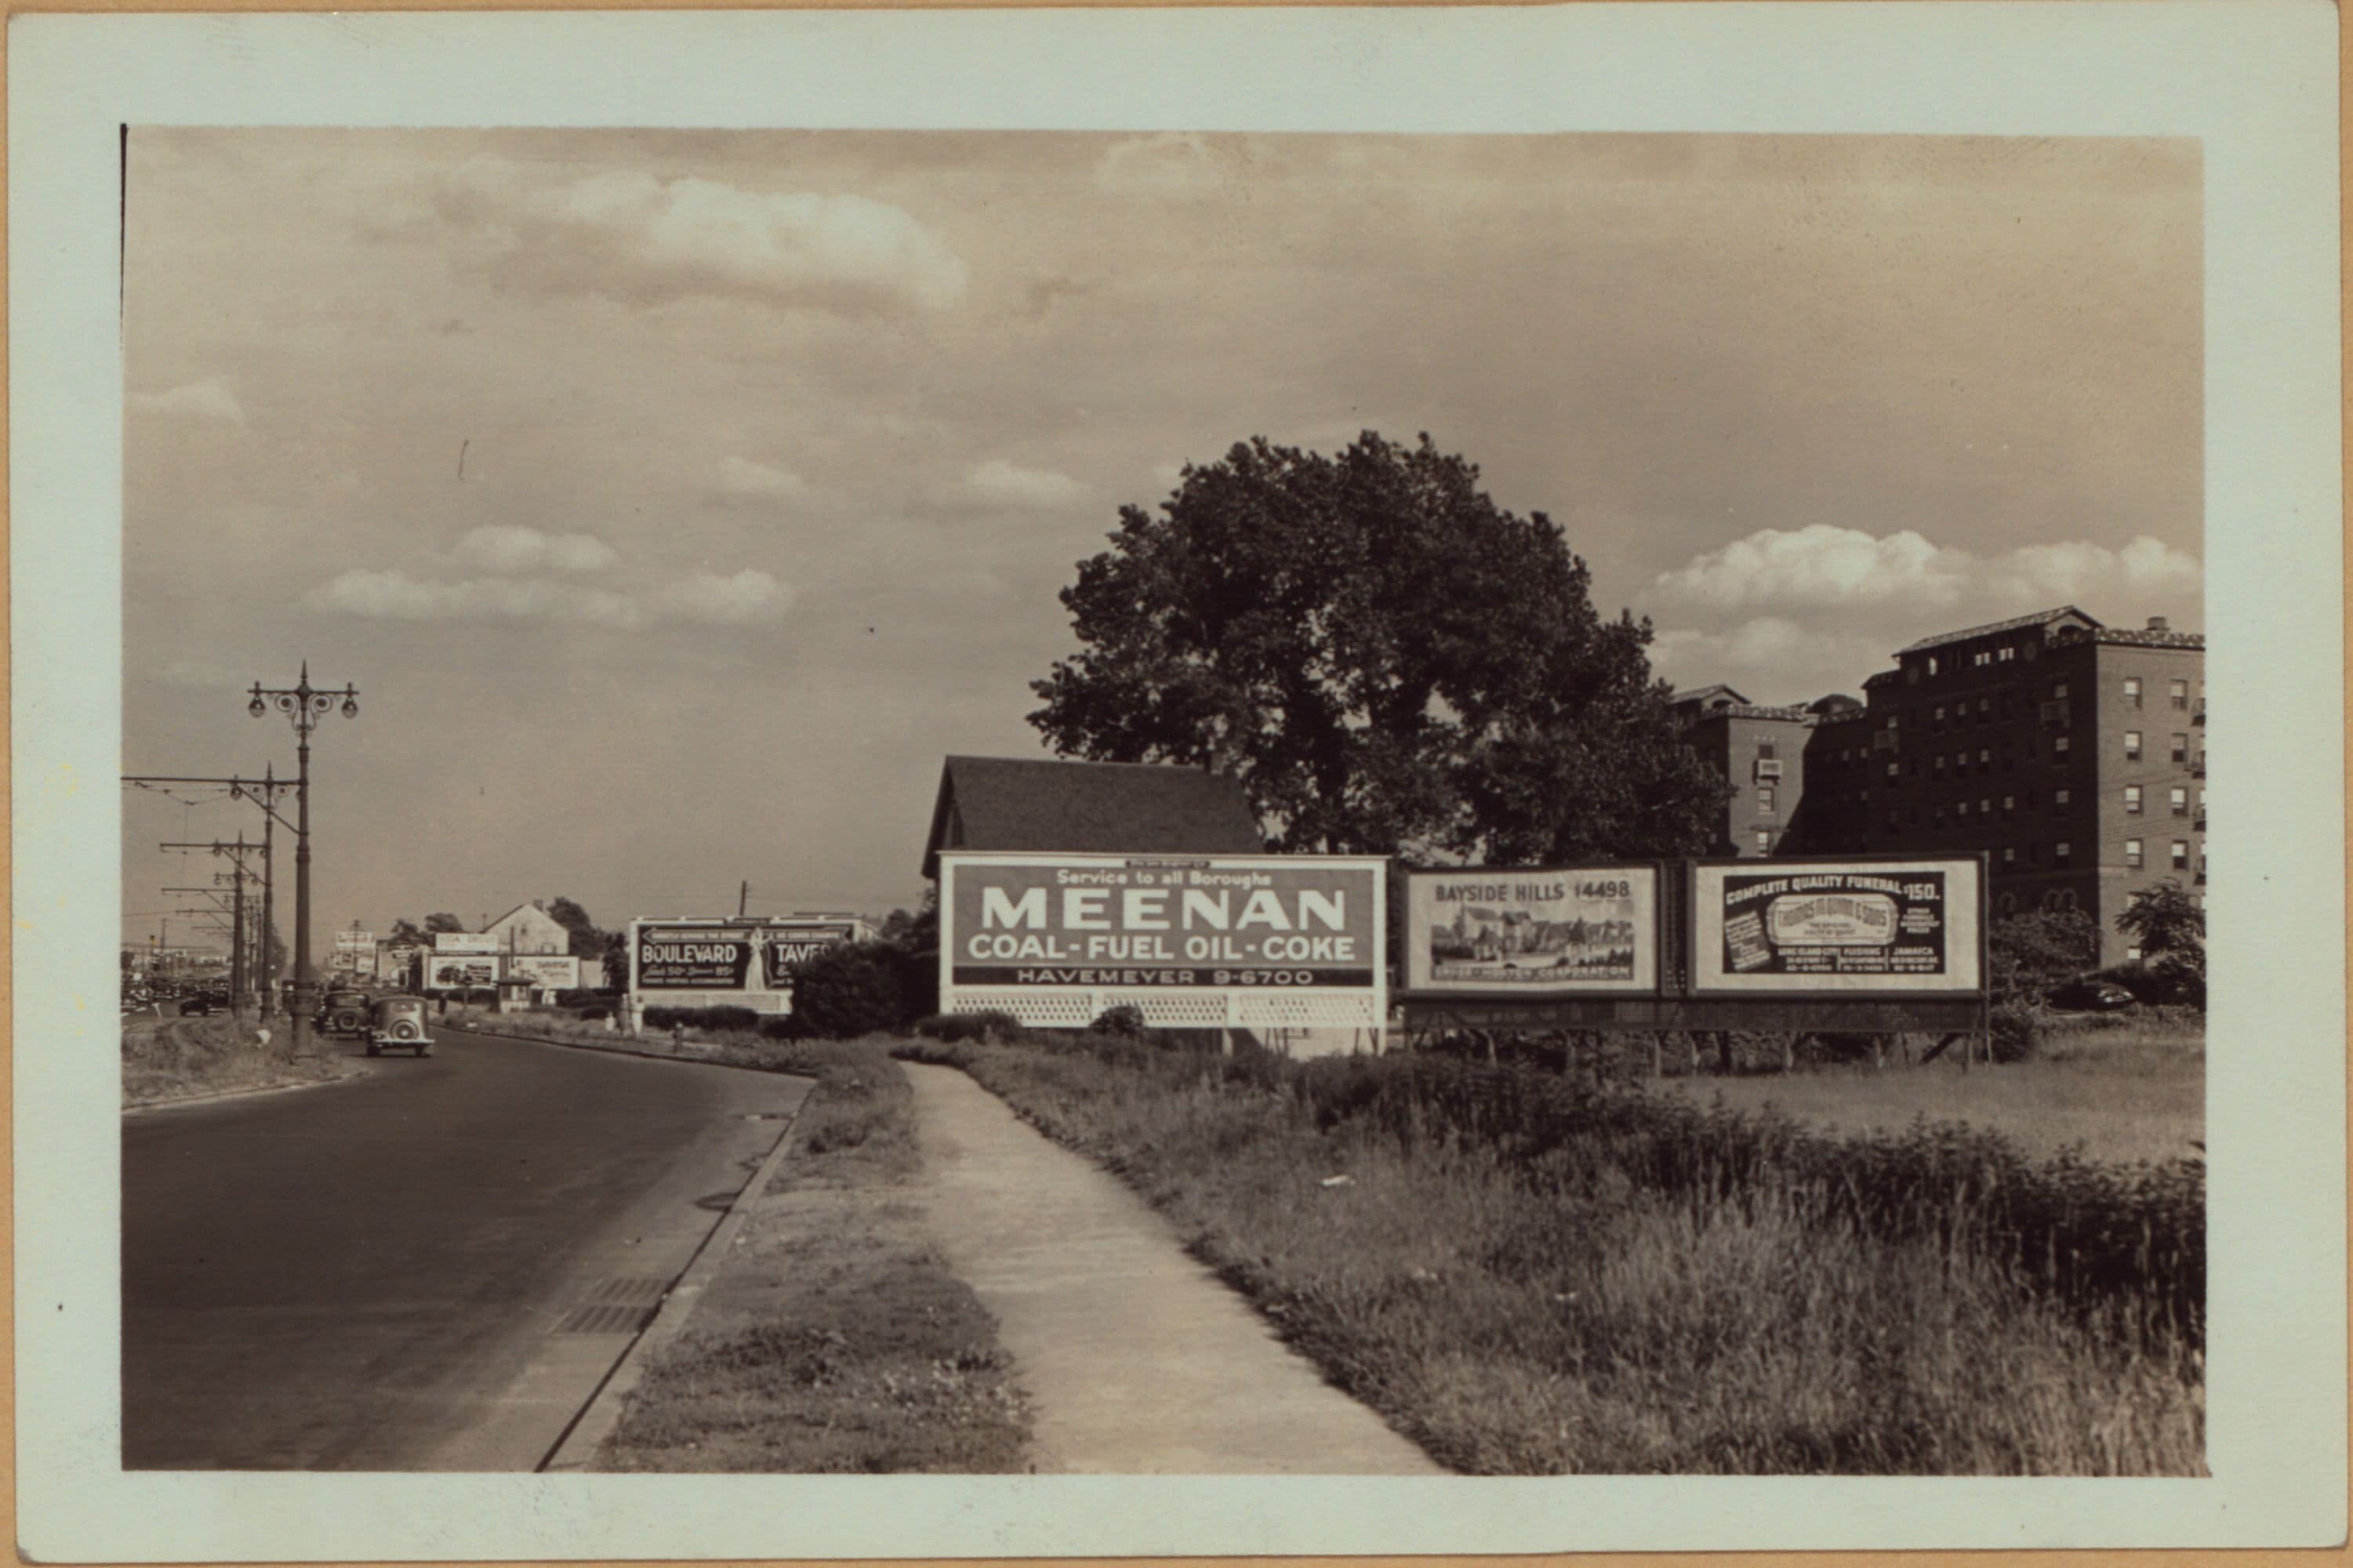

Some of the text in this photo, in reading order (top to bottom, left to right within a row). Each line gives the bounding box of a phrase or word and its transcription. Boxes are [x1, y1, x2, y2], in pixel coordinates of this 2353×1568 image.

[1057, 869, 1272, 891] Service to all Boroughs
[1726, 880, 1788, 905] COMPLETE
[1792, 876, 1843, 892] QUALITY
[1846, 875, 1902, 895] FUNERAL
[1436, 884, 1565, 902] BAYSIDE HILLS
[982, 887, 1345, 931] MEENAN
[641, 944, 738, 964] BOULEVARD
[1894, 946, 1934, 956] JAMAICA
[1018, 968, 1313, 985] HAVEMEYER 9-6700
